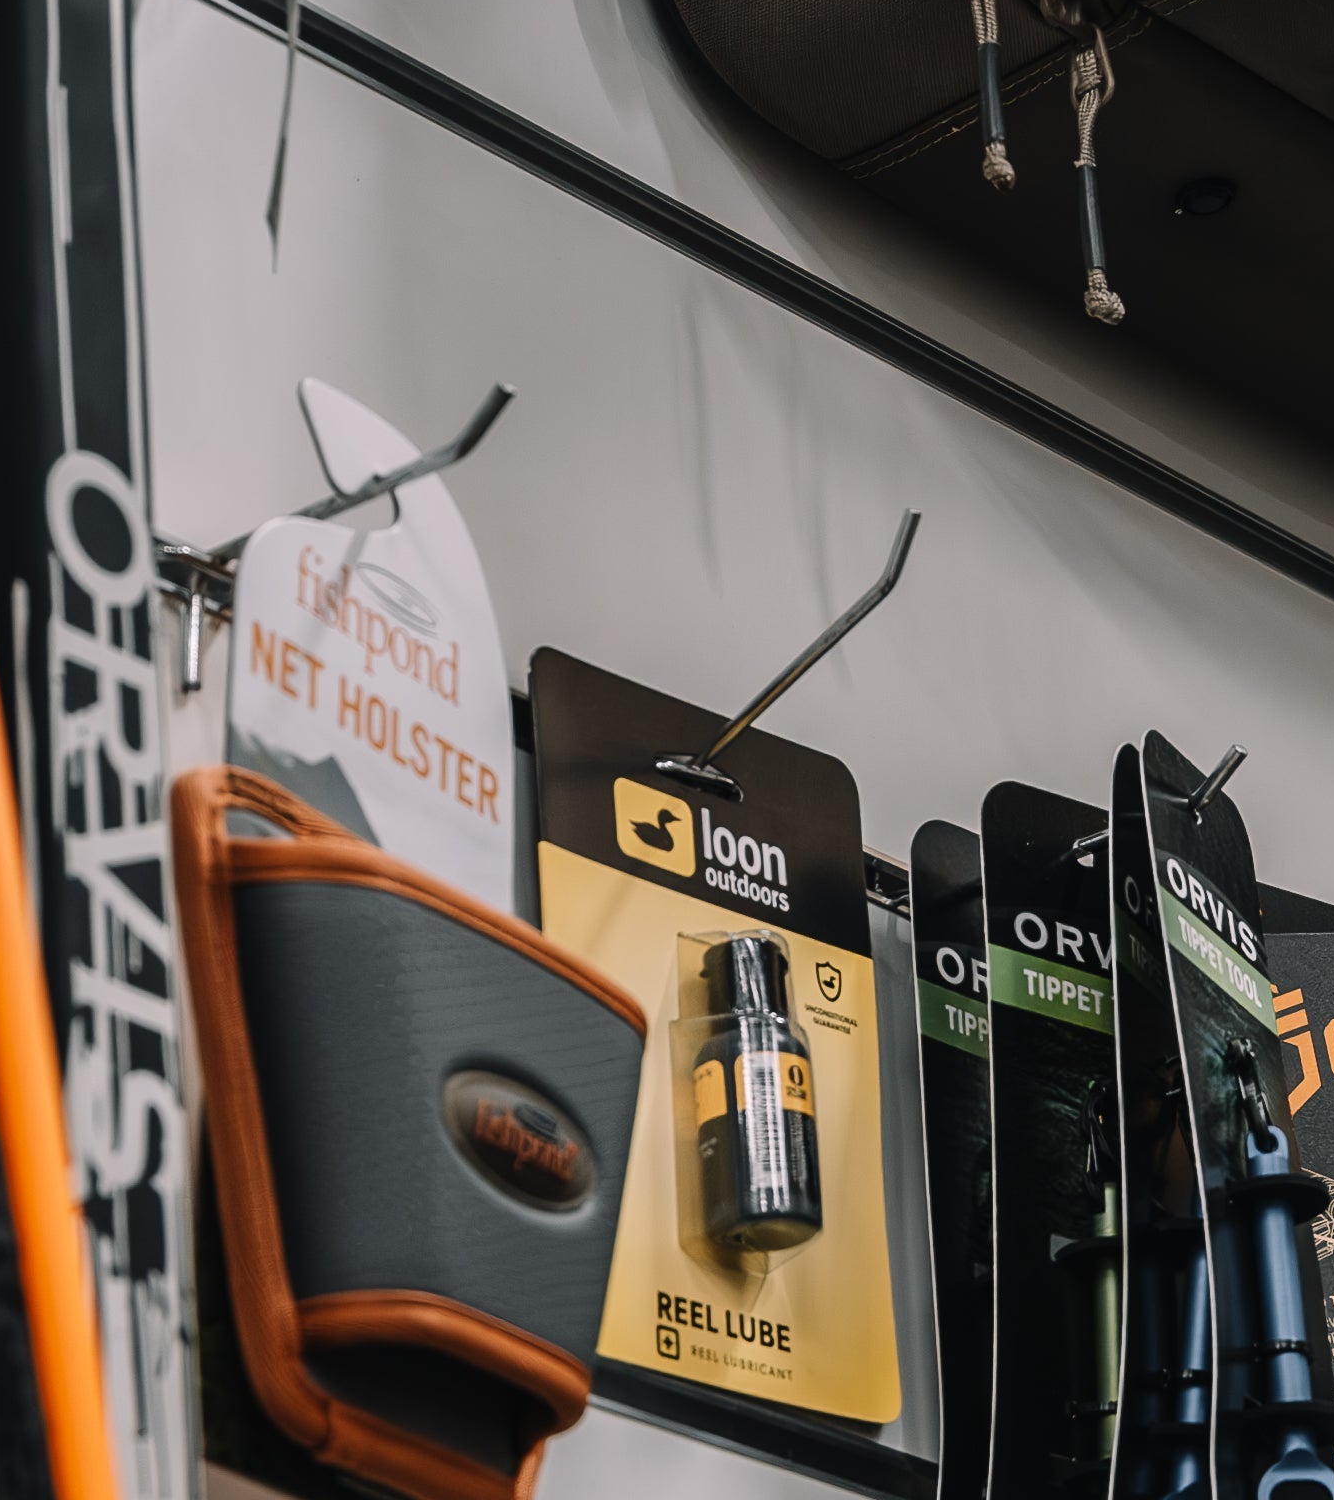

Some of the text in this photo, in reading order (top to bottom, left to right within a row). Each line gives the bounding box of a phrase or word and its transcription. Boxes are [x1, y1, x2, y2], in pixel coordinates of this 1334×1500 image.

[296, 544, 460, 707] fishpond
[250, 619, 501, 826] NET HOLSTER
[45, 448, 183, 1194] ORVIS
[700, 807, 788, 886] loon
[704, 866, 790, 912] outdoors
[1166, 857, 1258, 962] ORVIS
[1013, 911, 1112, 972] ORV
[1177, 913, 1226, 976] TIPPET
[1223, 956, 1263, 1009] TOOL
[944, 1003, 989, 1042] TIPP
[1022, 968, 1104, 1016] TIPPET
[657, 1289, 792, 1354] REEL LUBE
[724, 1353, 794, 1381] LUBRICANT
